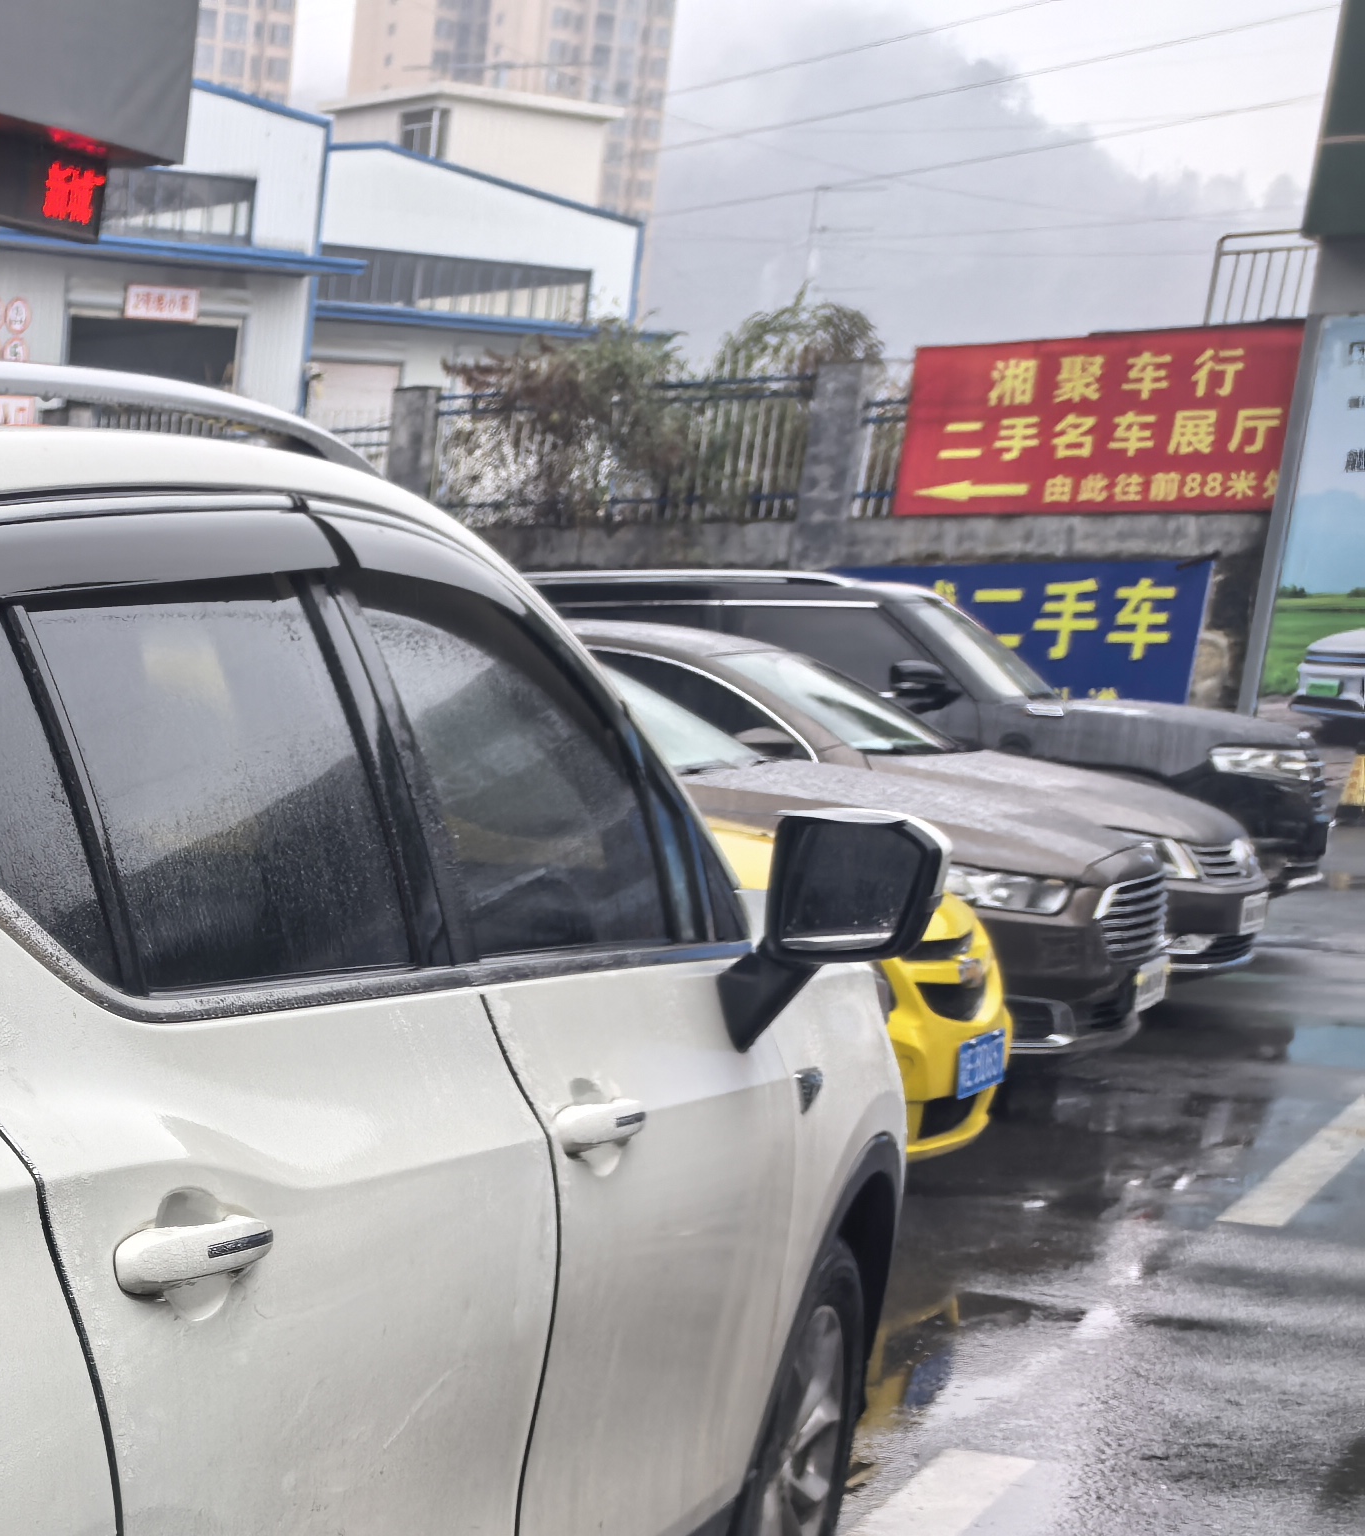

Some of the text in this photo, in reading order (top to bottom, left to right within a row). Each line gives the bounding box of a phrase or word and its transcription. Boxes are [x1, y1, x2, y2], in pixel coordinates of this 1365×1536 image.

[987, 347, 1246, 407] 湘聚车行
[937, 407, 1283, 461] 二手名车展厅
[935, 578, 1176, 661] 二手车
